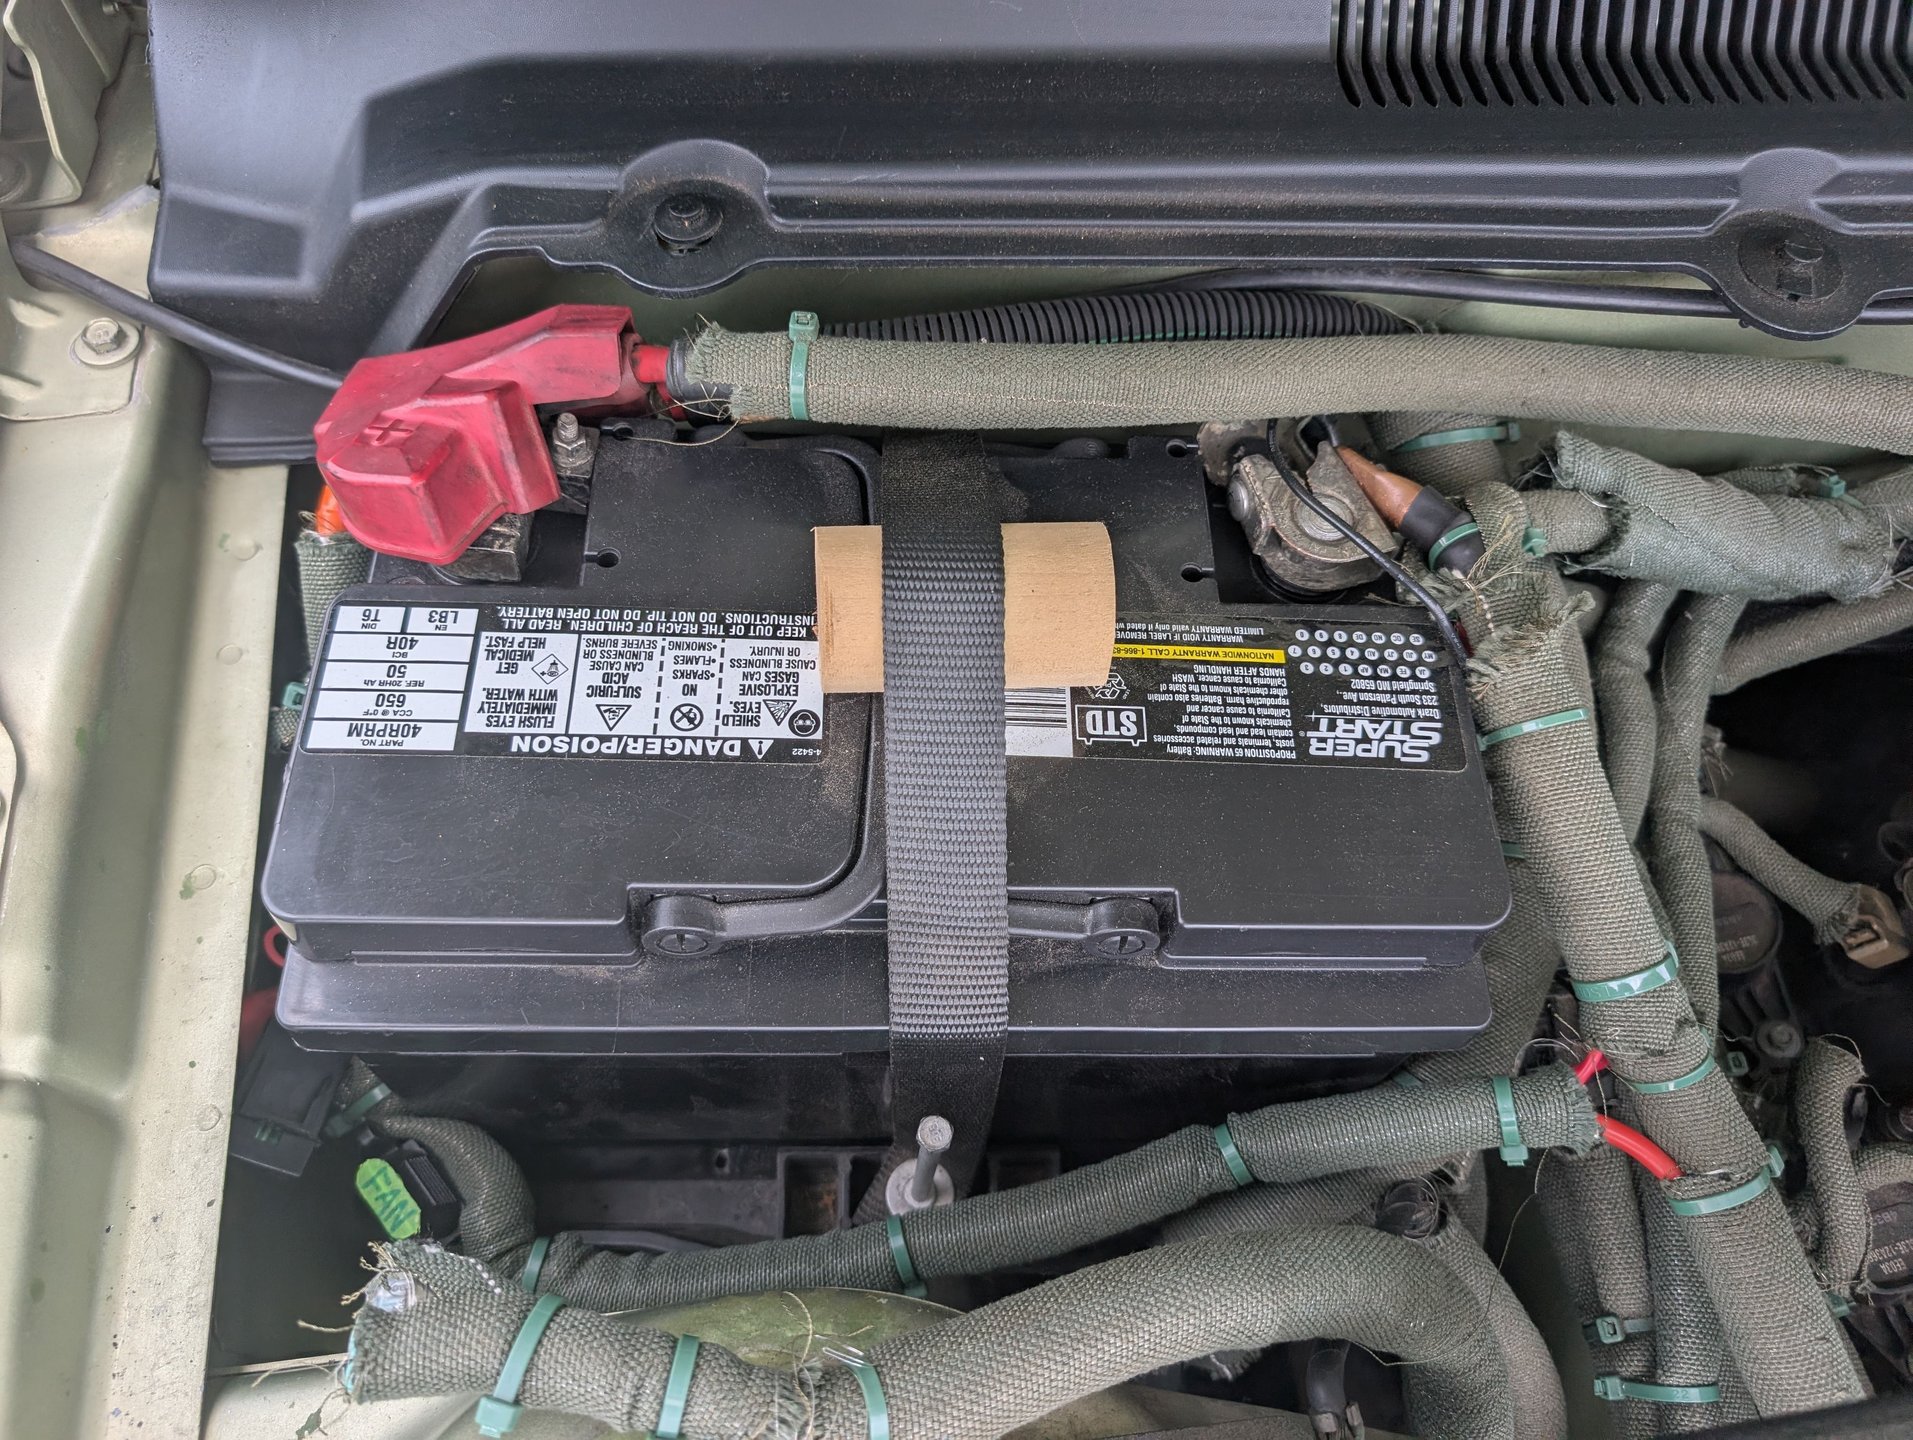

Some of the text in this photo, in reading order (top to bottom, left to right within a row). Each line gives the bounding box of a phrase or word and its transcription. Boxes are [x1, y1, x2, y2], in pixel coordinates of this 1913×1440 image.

[362, 609, 380, 621] T6
[428, 610, 458, 623] LB3
[496, 606, 814, 626] INSTRUCTIONS. DO NOT TIP. DO NOT OPEN BATTERY.
[502, 618, 806, 638] KEEP OUT OF THE REACH OF CHILDREN. READ ALL
[1155, 622, 1170, 630] only
[1191, 625, 1232, 633] WARRANTY
[1234, 627, 1264, 635] LIMITED
[386, 637, 419, 650] 40R
[485, 636, 546, 649] HELP FAST.
[582, 638, 657, 649] SEVERE BURNS.
[1202, 634, 1243, 643] WARRANTY
[485, 649, 535, 661] MEDICAL
[583, 649, 654, 660] BLINDNESS OR
[749, 646, 800, 656] OR INJURY.
[1173, 649, 1220, 657] WARRANTY
[1222, 651, 1274, 660] NATIONWIDE
[496, 662, 518, 674] GET
[590, 661, 644, 672] CAN CAUSE
[730, 658, 816, 670] CAUSE BLINDNESS
[387, 664, 407, 678] 50
[1194, 665, 1285, 676] HANDS AFTER HANDLING
[602, 672, 629, 684] ACID
[742, 671, 799, 683] GASES CAN
[1172, 674, 1194, 682] WASH
[1253, 677, 1286, 686] California
[682, 684, 697, 696] NO
[739, 684, 799, 696] EXPLOSIVE
[1169, 684, 1186, 692] State
[1189, 684, 1199, 692] the
[1209, 685, 1231, 694] known
[1233, 686, 1268, 695] chemicals
[1350, 679, 1435, 691] Springfield MO 65802
[482, 688, 558, 701] WITH WATER.
[586, 685, 642, 698] SULFURIC
[1270, 688, 1287, 696] other
[375, 694, 406, 707] 650
[1175, 694, 1189, 702] also
[1191, 694, 1222, 704] Batteries
[1224, 696, 1244, 705] harm.
[1246, 697, 1289, 706] reproductive
[1359, 692, 1396, 703] Patterson
[1398, 694, 1419, 704] South
[1422, 695, 1438, 705] 233
[477, 701, 557, 714] IMMEDIATELY
[729, 701, 761, 713] EYES.
[1257, 708, 1290, 717] California
[1320, 704, 1440, 718] Ozark Automotive Distributors,
[486, 715, 555, 728] FLUSH EYES
[722, 714, 761, 727] SHIELD
[1085, 710, 1137, 736] STD
[1182, 715, 1189, 723] of
[1191, 715, 1209, 724] State
[1232, 717, 1254, 726] known
[1256, 718, 1291, 727] chemicals
[347, 723, 422, 738] 40RPRM
[1174, 724, 1216, 734] compounds,
[1219, 727, 1234, 735] lead
[1250, 728, 1265, 736] lead
[1307, 718, 1442, 744] START
[1153, 735, 1195, 743] accessories
[1196, 736, 1221, 744] related
[1238, 738, 1271, 746] terminals
[1273, 738, 1294, 747] posts,
[511, 736, 741, 756] DANGER/POISON
[1167, 744, 1296, 759] PROPOSITION 65 WARNING: Battery
[1309, 738, 1430, 762] SUPER
[357, 1166, 402, 1232] FAN
